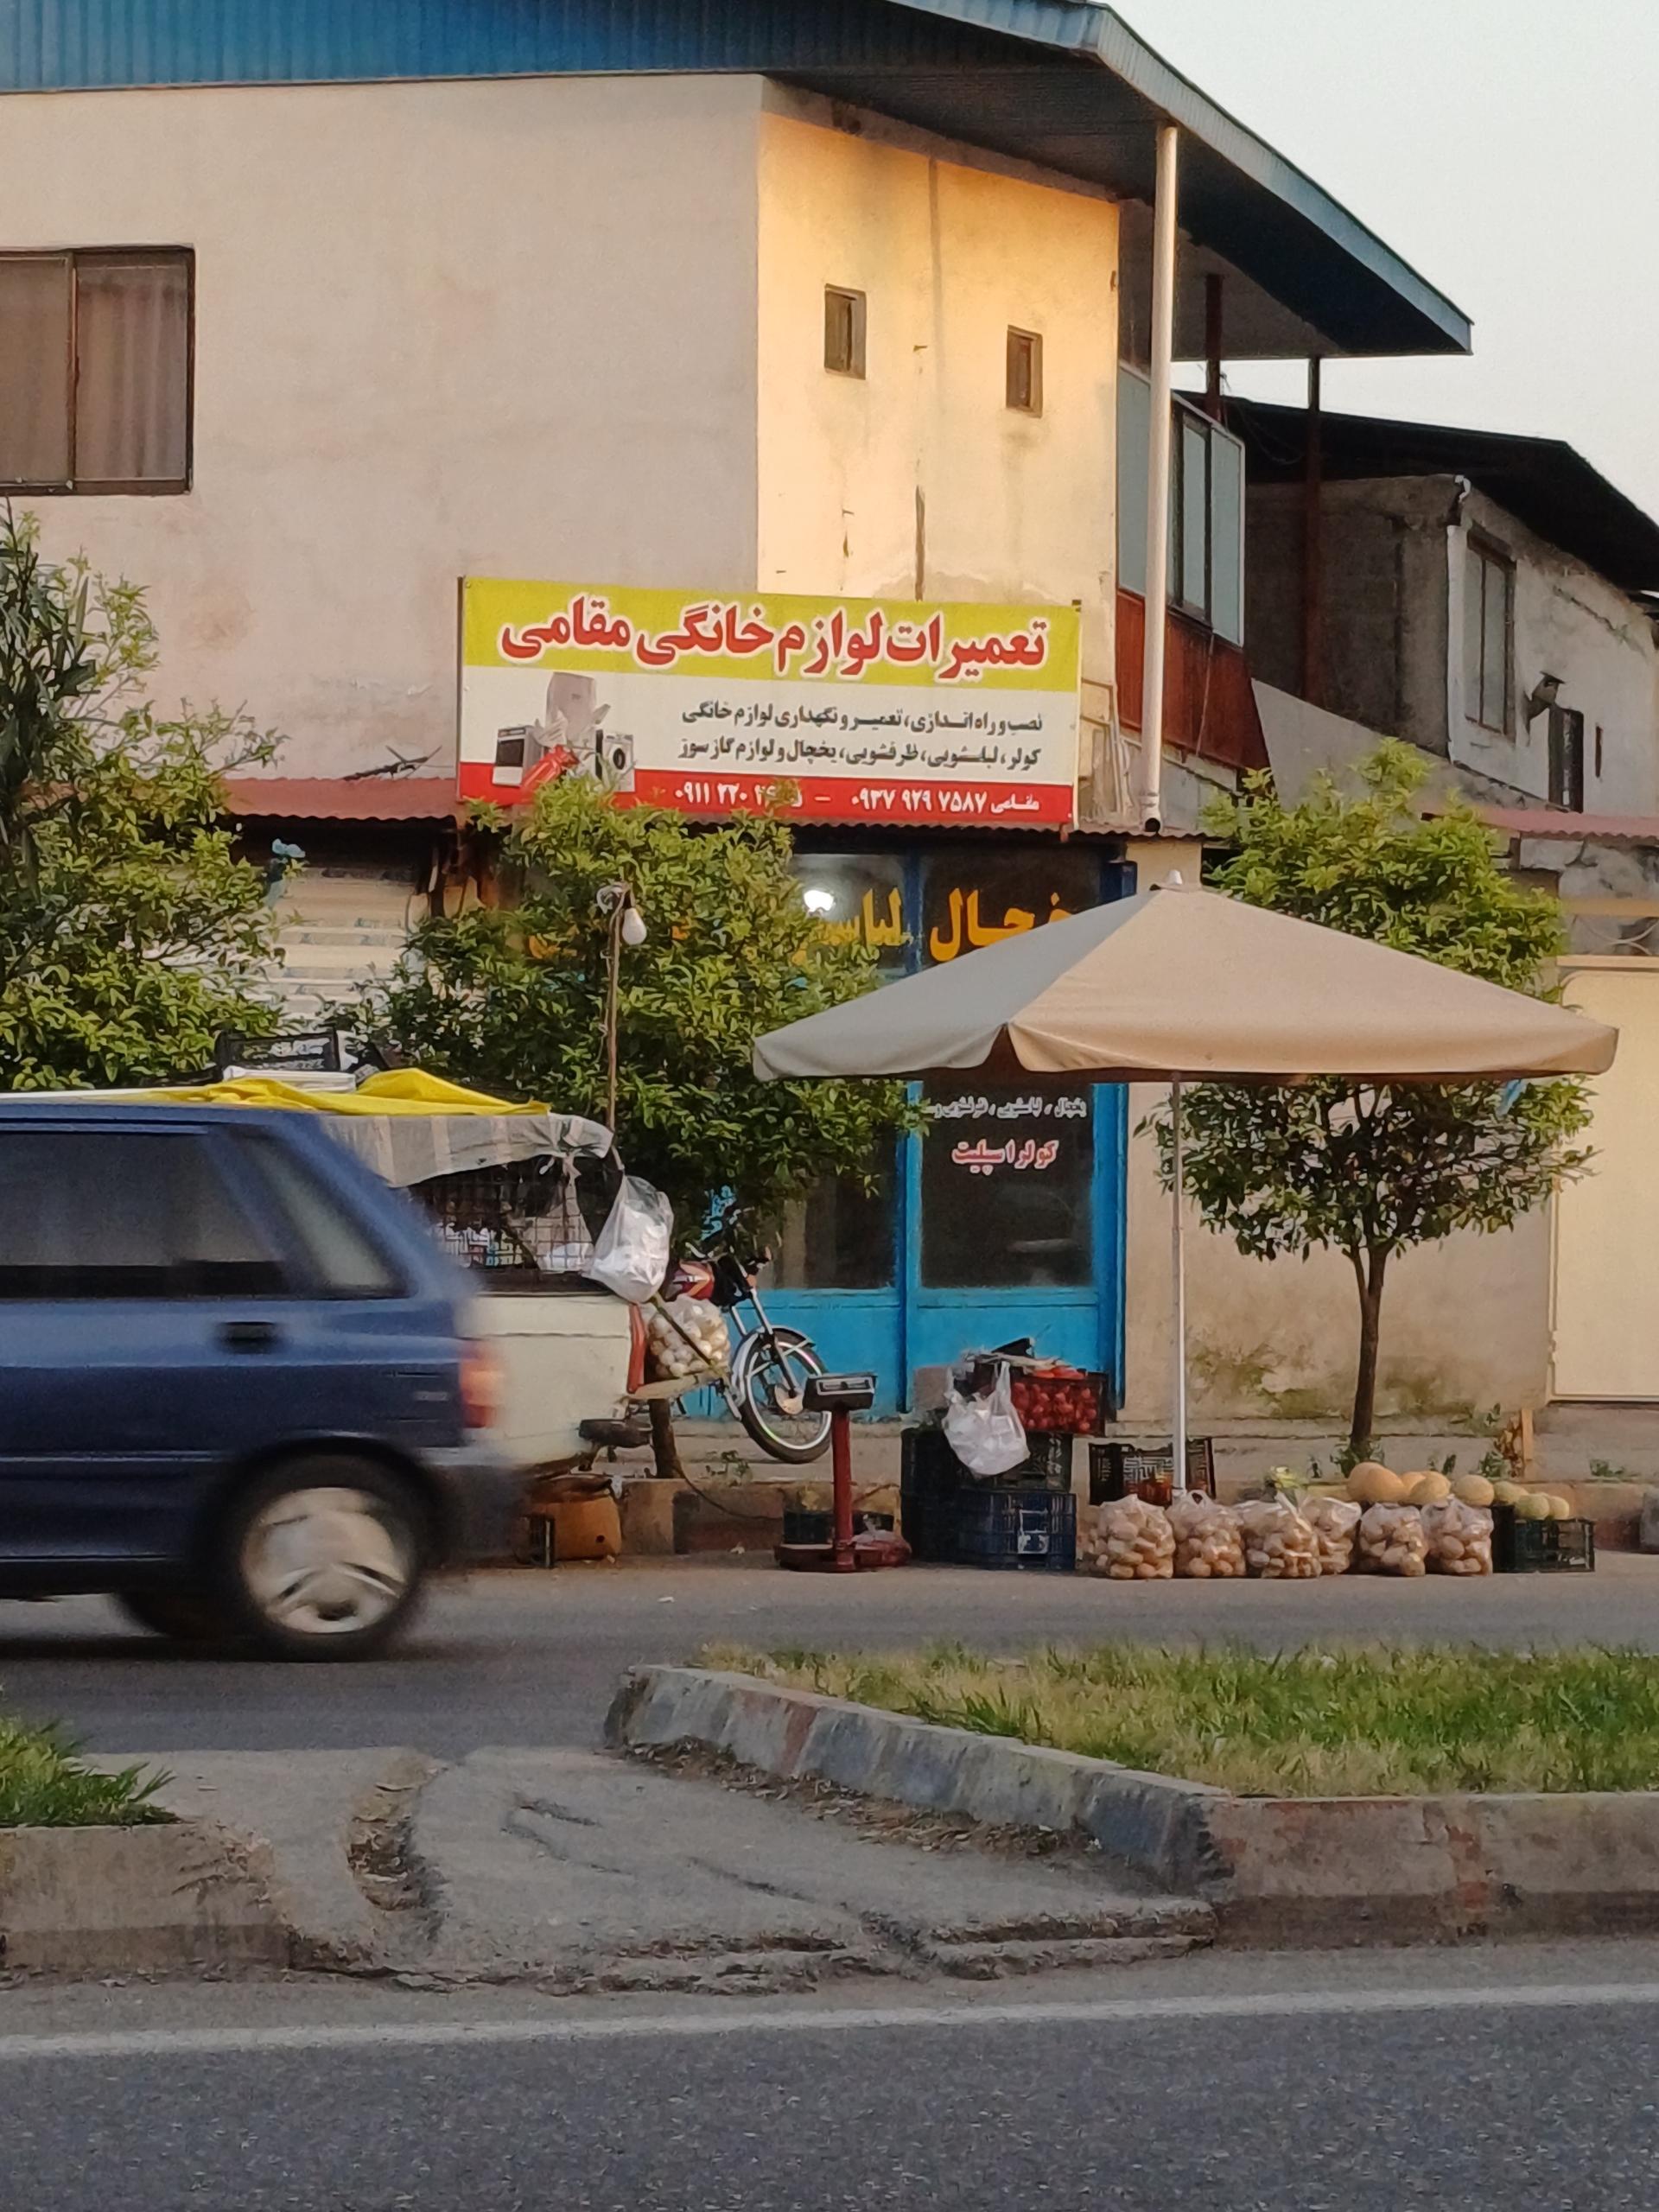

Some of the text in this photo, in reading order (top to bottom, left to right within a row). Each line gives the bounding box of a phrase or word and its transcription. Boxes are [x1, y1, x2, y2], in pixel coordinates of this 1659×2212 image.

[500, 594, 1048, 680] تعمیرات لوازم خانگی مقامی
[682, 699, 732, 723] خانگی
[734, 702, 773, 727] لوازم
[774, 704, 838, 729] نگهداری
[849, 708, 903, 731] تعمیر
[1007, 713, 1043, 736] نصب
[735, 737, 775, 761] لوازم
[786, 739, 836, 764] یخچال
[674, 780, 710, 805] ۰۹۱۱
[951, 1137, 1060, 1176] کولر اسپلیت
